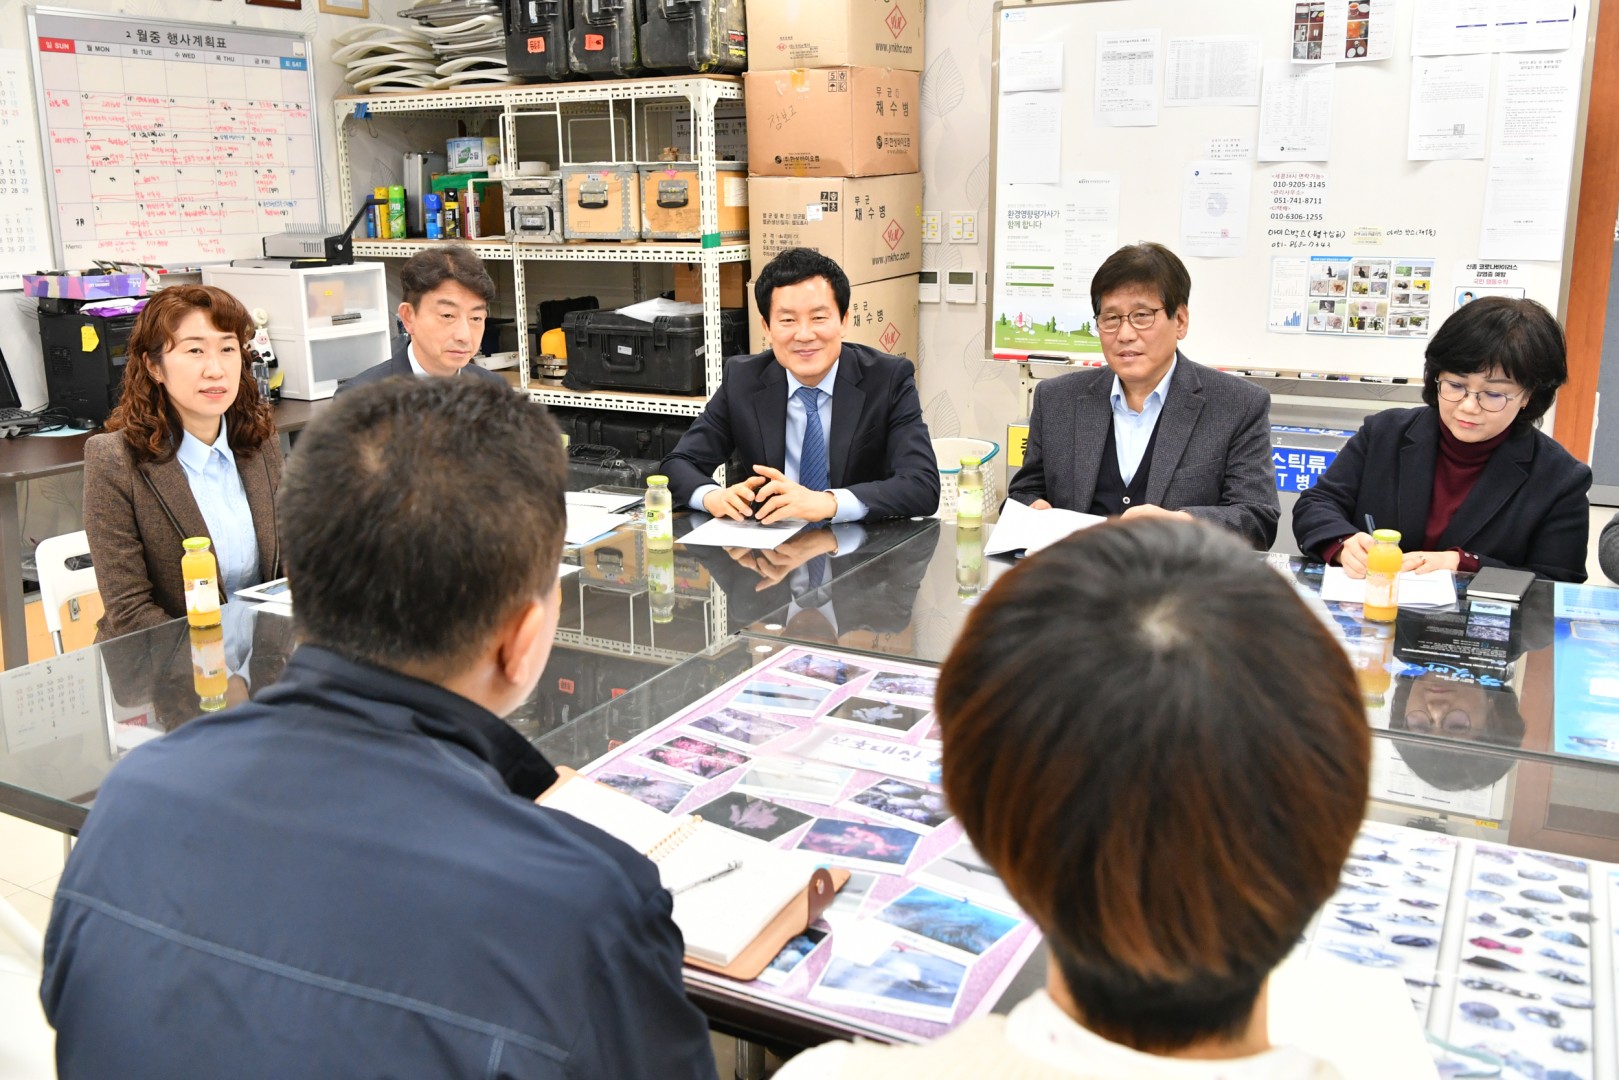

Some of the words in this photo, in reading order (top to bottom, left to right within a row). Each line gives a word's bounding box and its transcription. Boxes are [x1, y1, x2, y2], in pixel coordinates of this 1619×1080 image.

[137, 29, 161, 44] 월중
[168, 32, 227, 49] 행사계획표
[875, 42, 913, 54] www.ynkhc.com
[1007, 210, 1061, 219] 환경영향평가사가
[1007, 220, 1021, 229] 함께
[1022, 220, 1042, 230] 합니다
[872, 251, 910, 266] www.ynkhc.com
